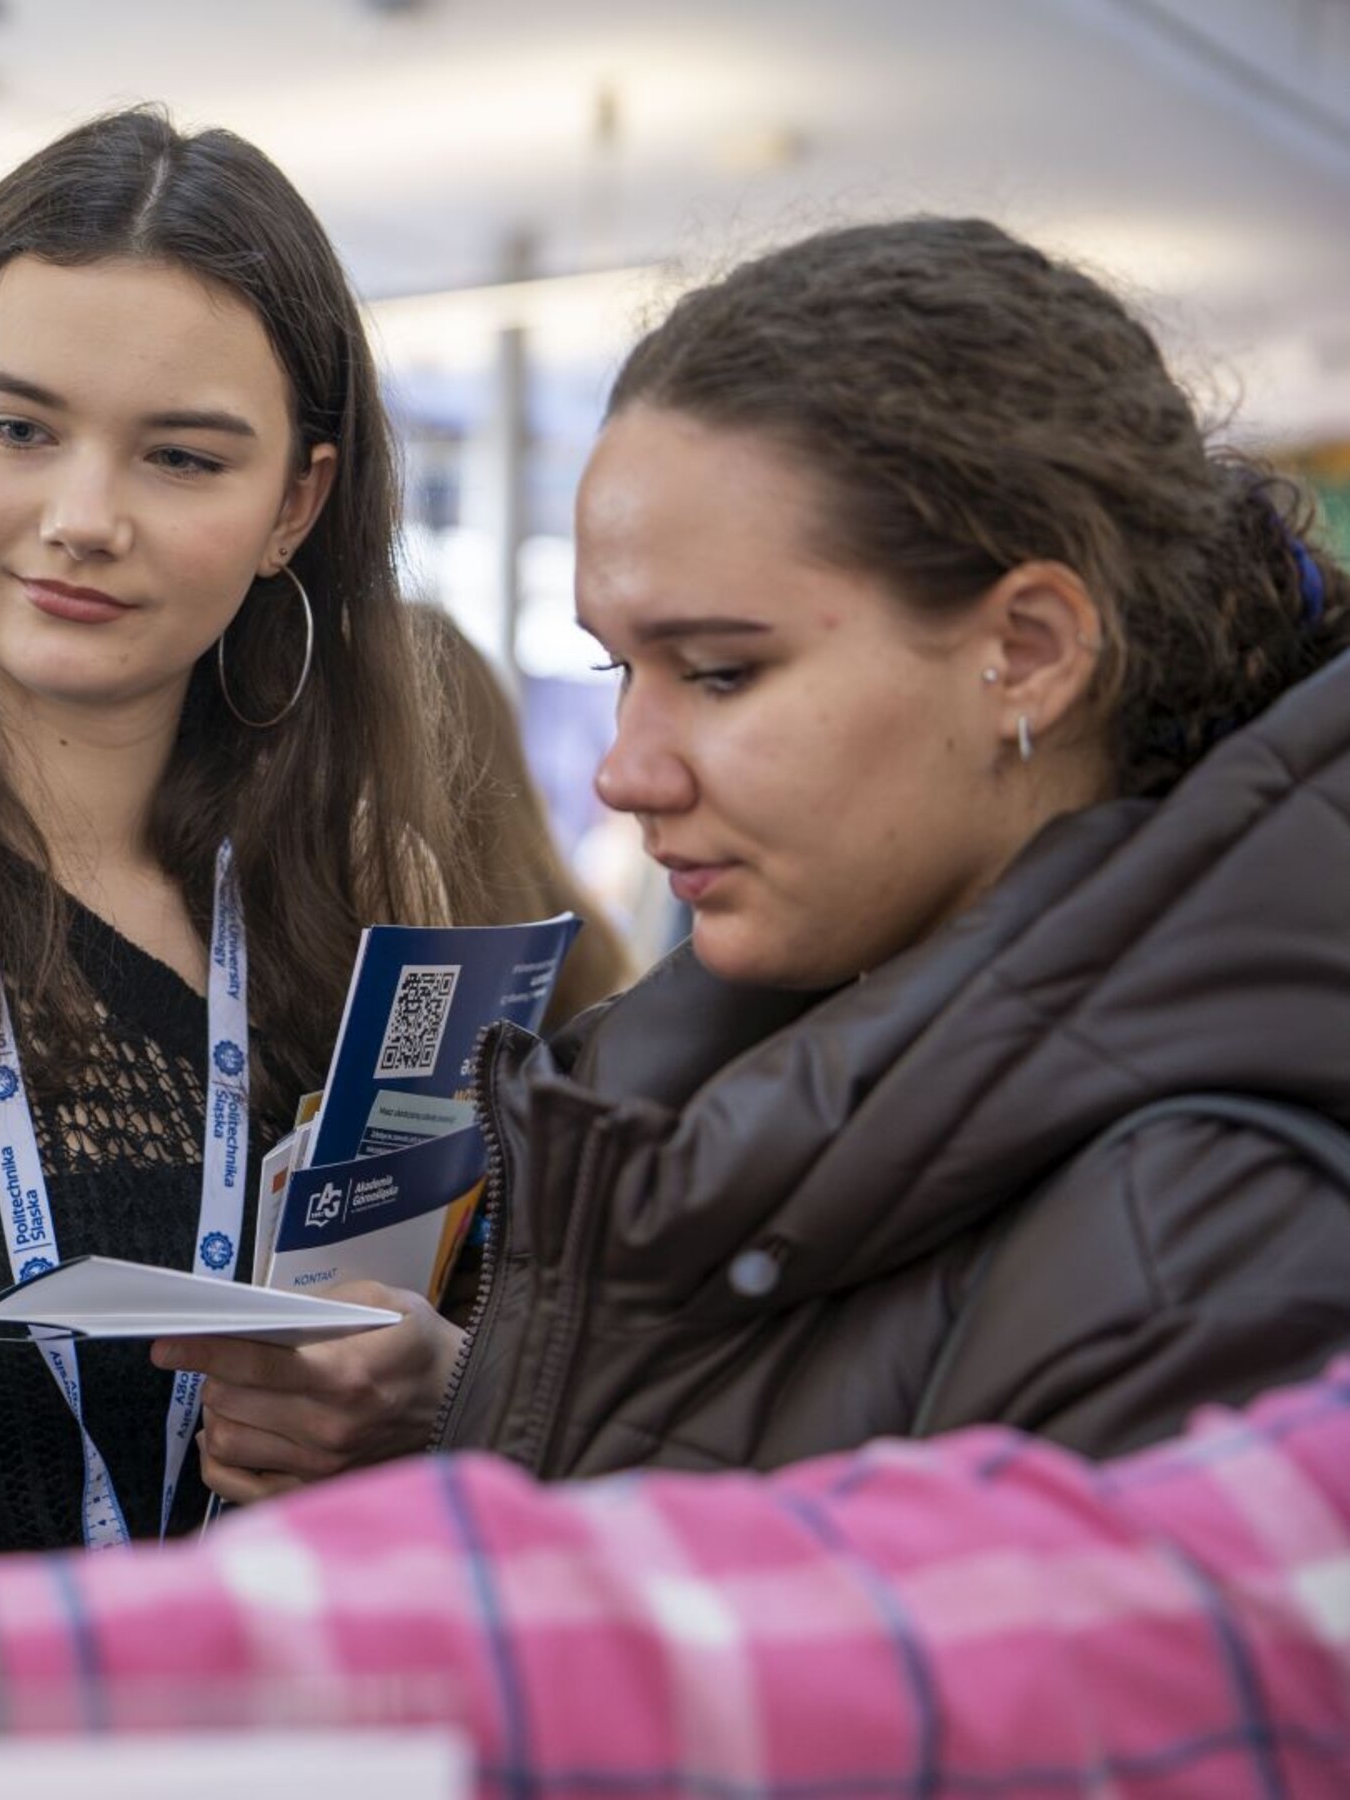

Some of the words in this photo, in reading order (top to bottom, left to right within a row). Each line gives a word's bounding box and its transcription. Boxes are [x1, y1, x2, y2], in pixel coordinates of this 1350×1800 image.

[227, 922, 240, 1000] University
[224, 1092, 240, 1187] Politechnika
[2, 1146, 30, 1245] Politechnika
[294, 1268, 338, 1286] KONTAKT
